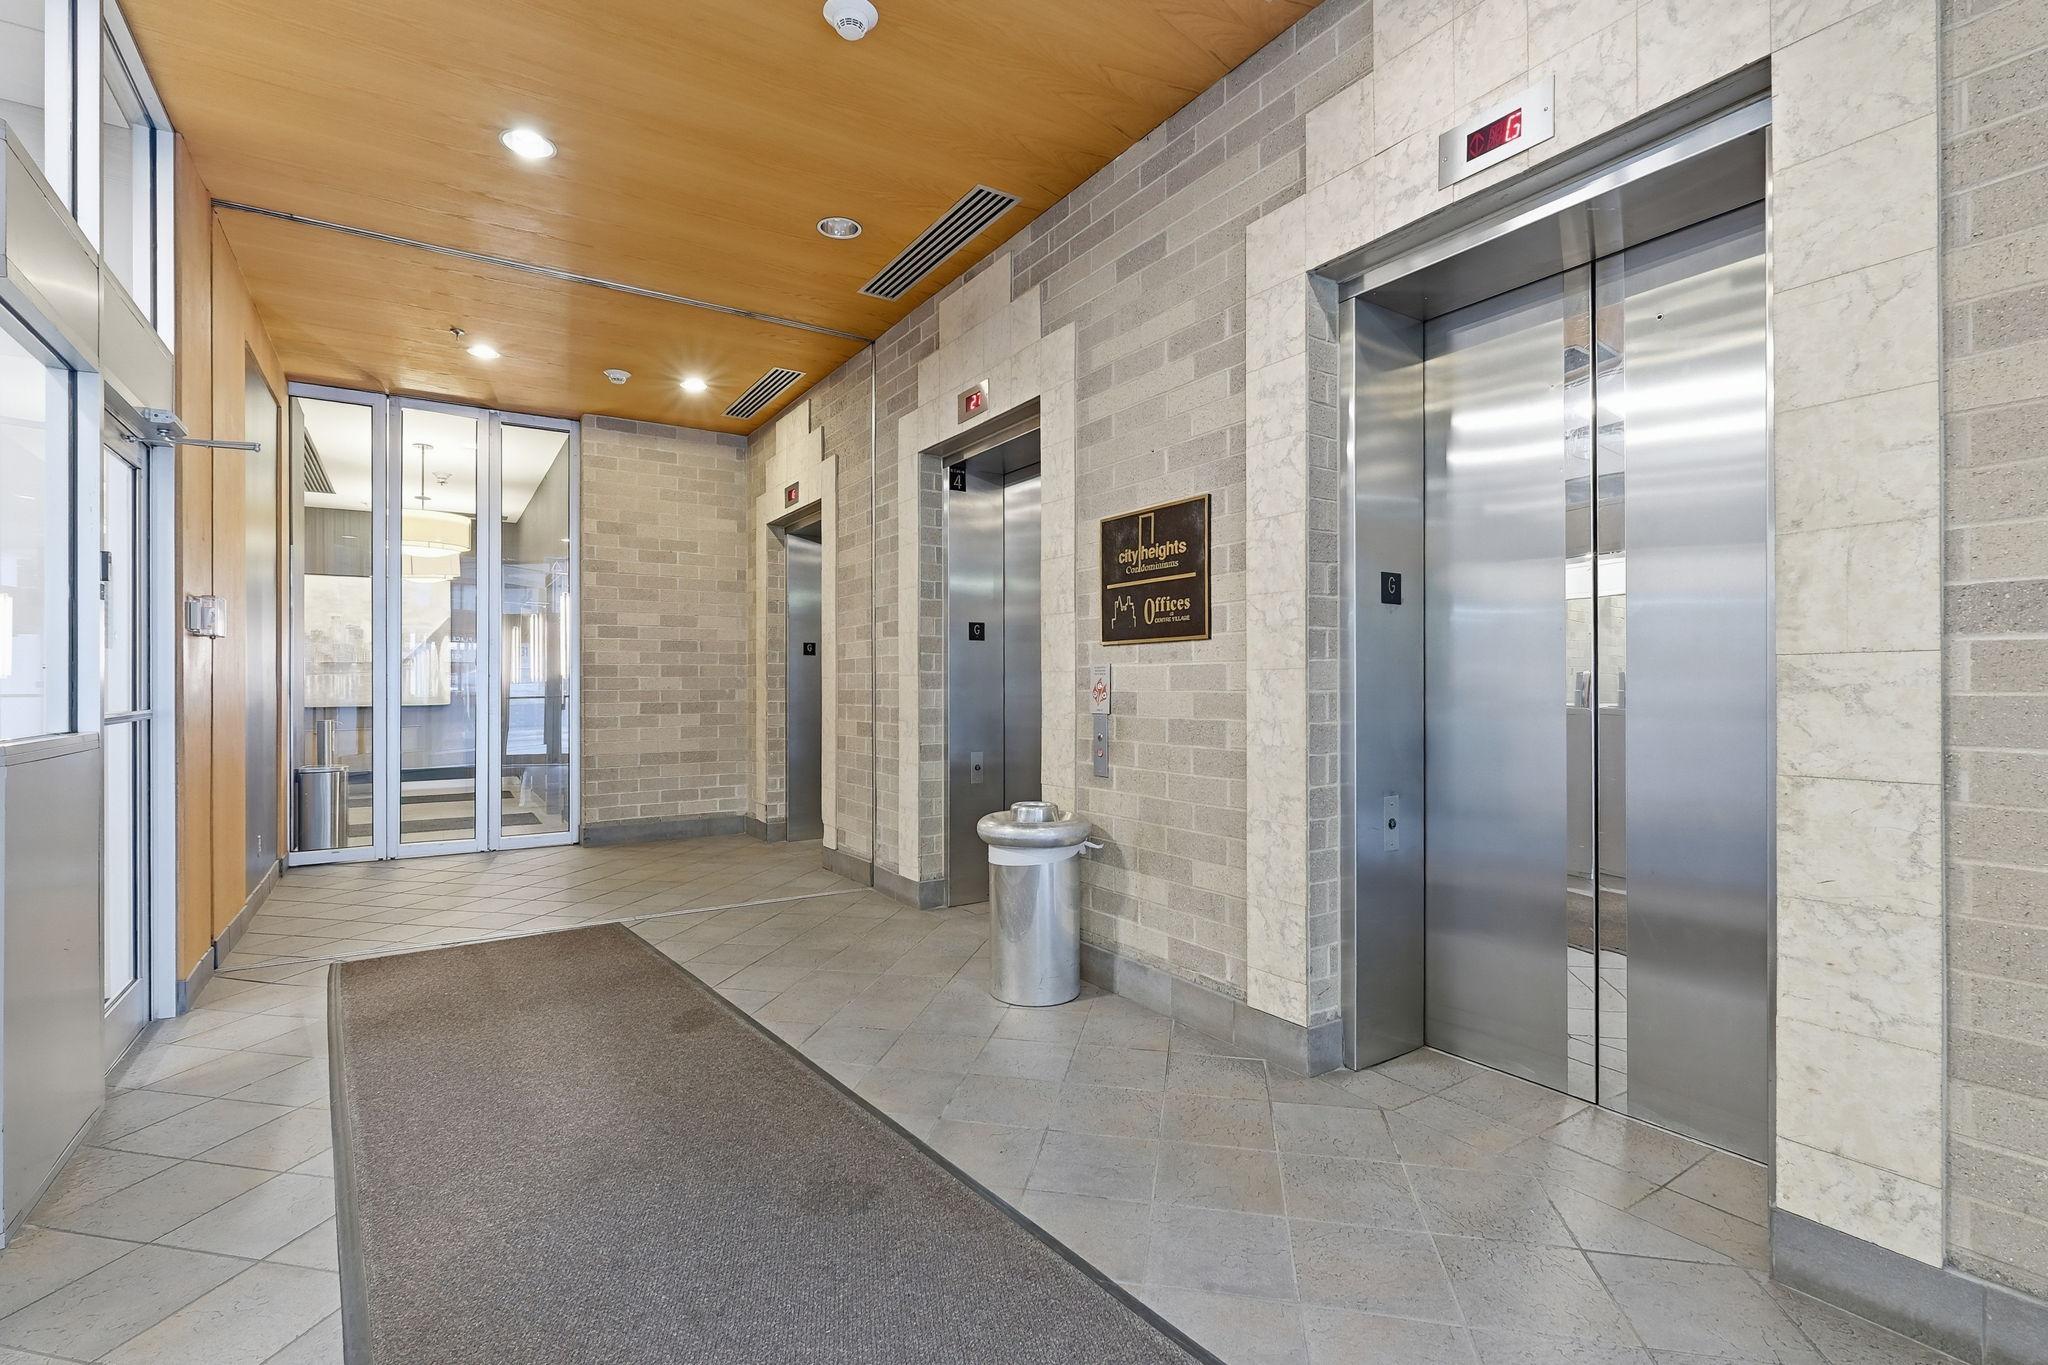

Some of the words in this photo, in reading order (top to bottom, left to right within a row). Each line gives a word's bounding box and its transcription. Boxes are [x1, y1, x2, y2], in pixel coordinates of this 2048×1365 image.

[1505, 111, 1522, 142] G
[953, 474, 963, 489] 4
[1118, 549, 1139, 566] city
[1140, 540, 1187, 560] heights
[1388, 576, 1396, 594] G
[1144, 596, 1191, 625] Offices
[973, 624, 980, 635] G
